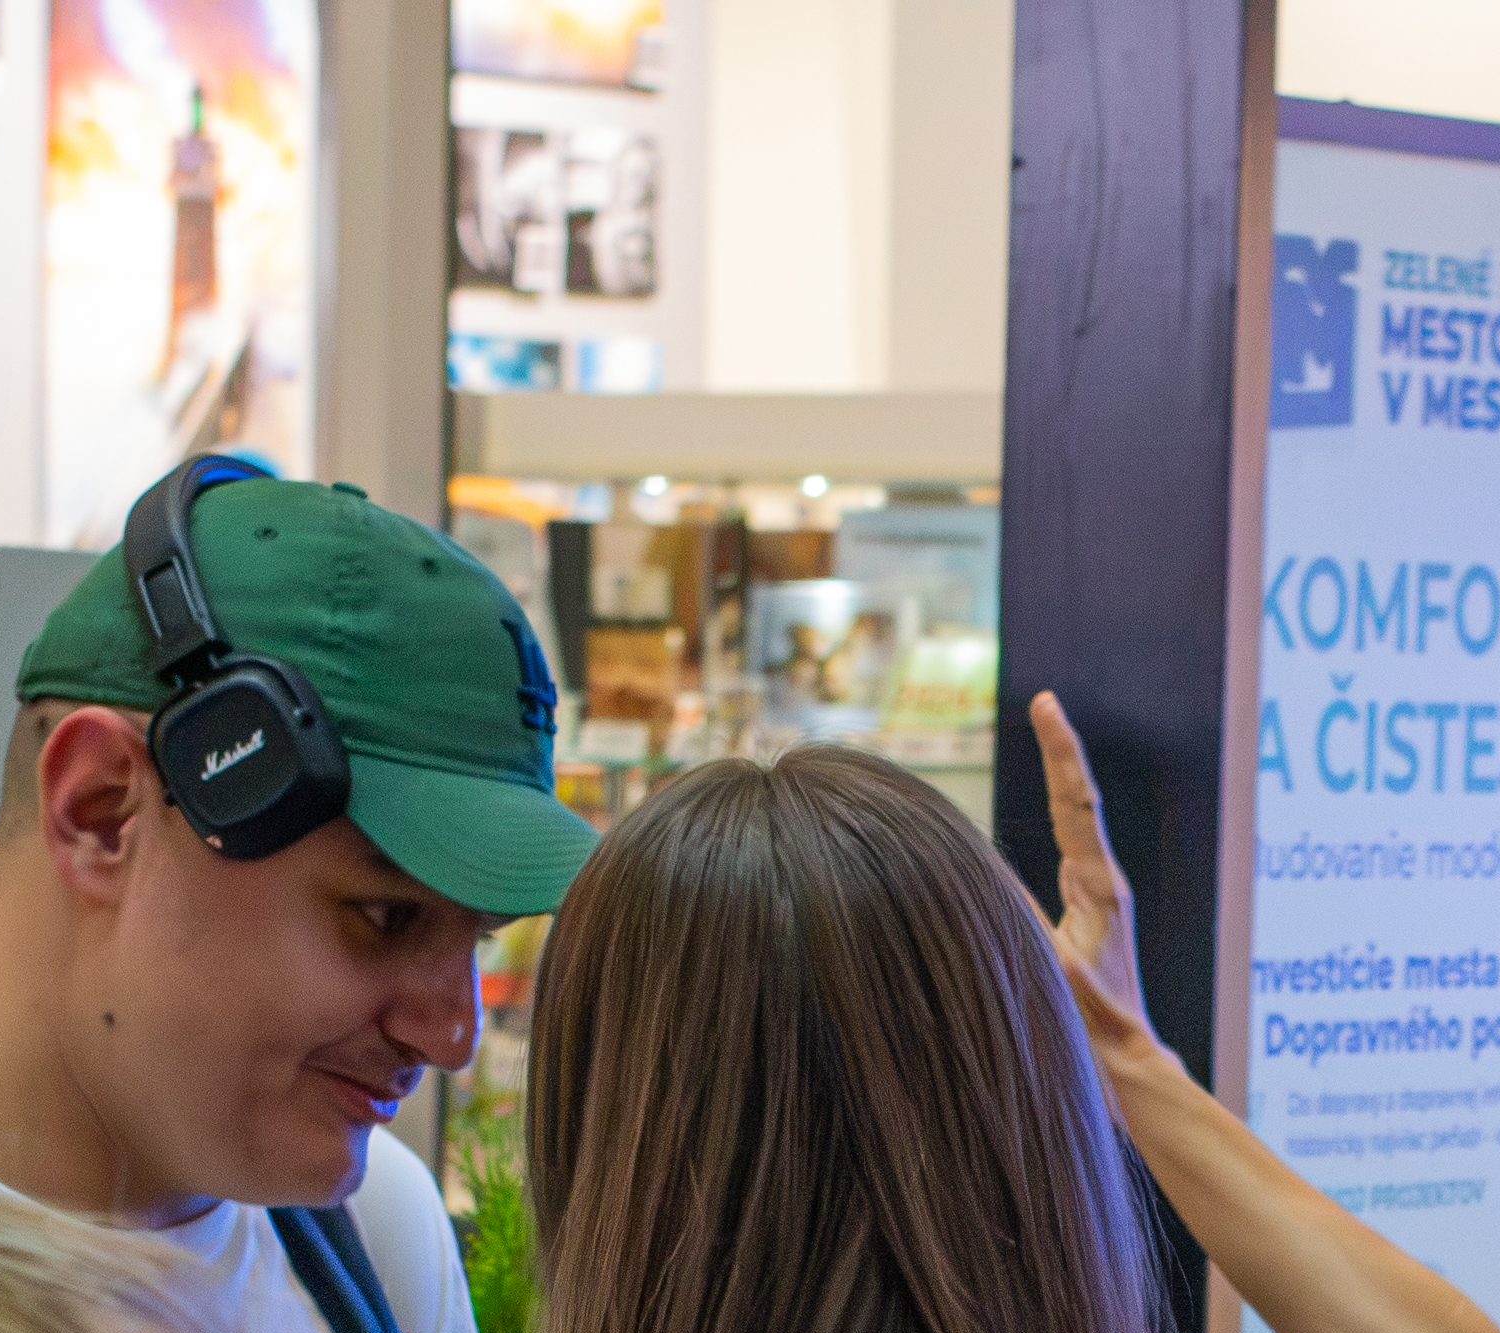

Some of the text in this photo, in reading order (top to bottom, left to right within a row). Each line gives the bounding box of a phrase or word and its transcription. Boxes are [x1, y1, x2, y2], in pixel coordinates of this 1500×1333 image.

[1378, 370, 1411, 426] V
[1258, 697, 1295, 793] A
[1256, 829, 1418, 880] udovanie
[1404, 949, 1500, 990] mesta
[1264, 1004, 1464, 1067] Dopravného
